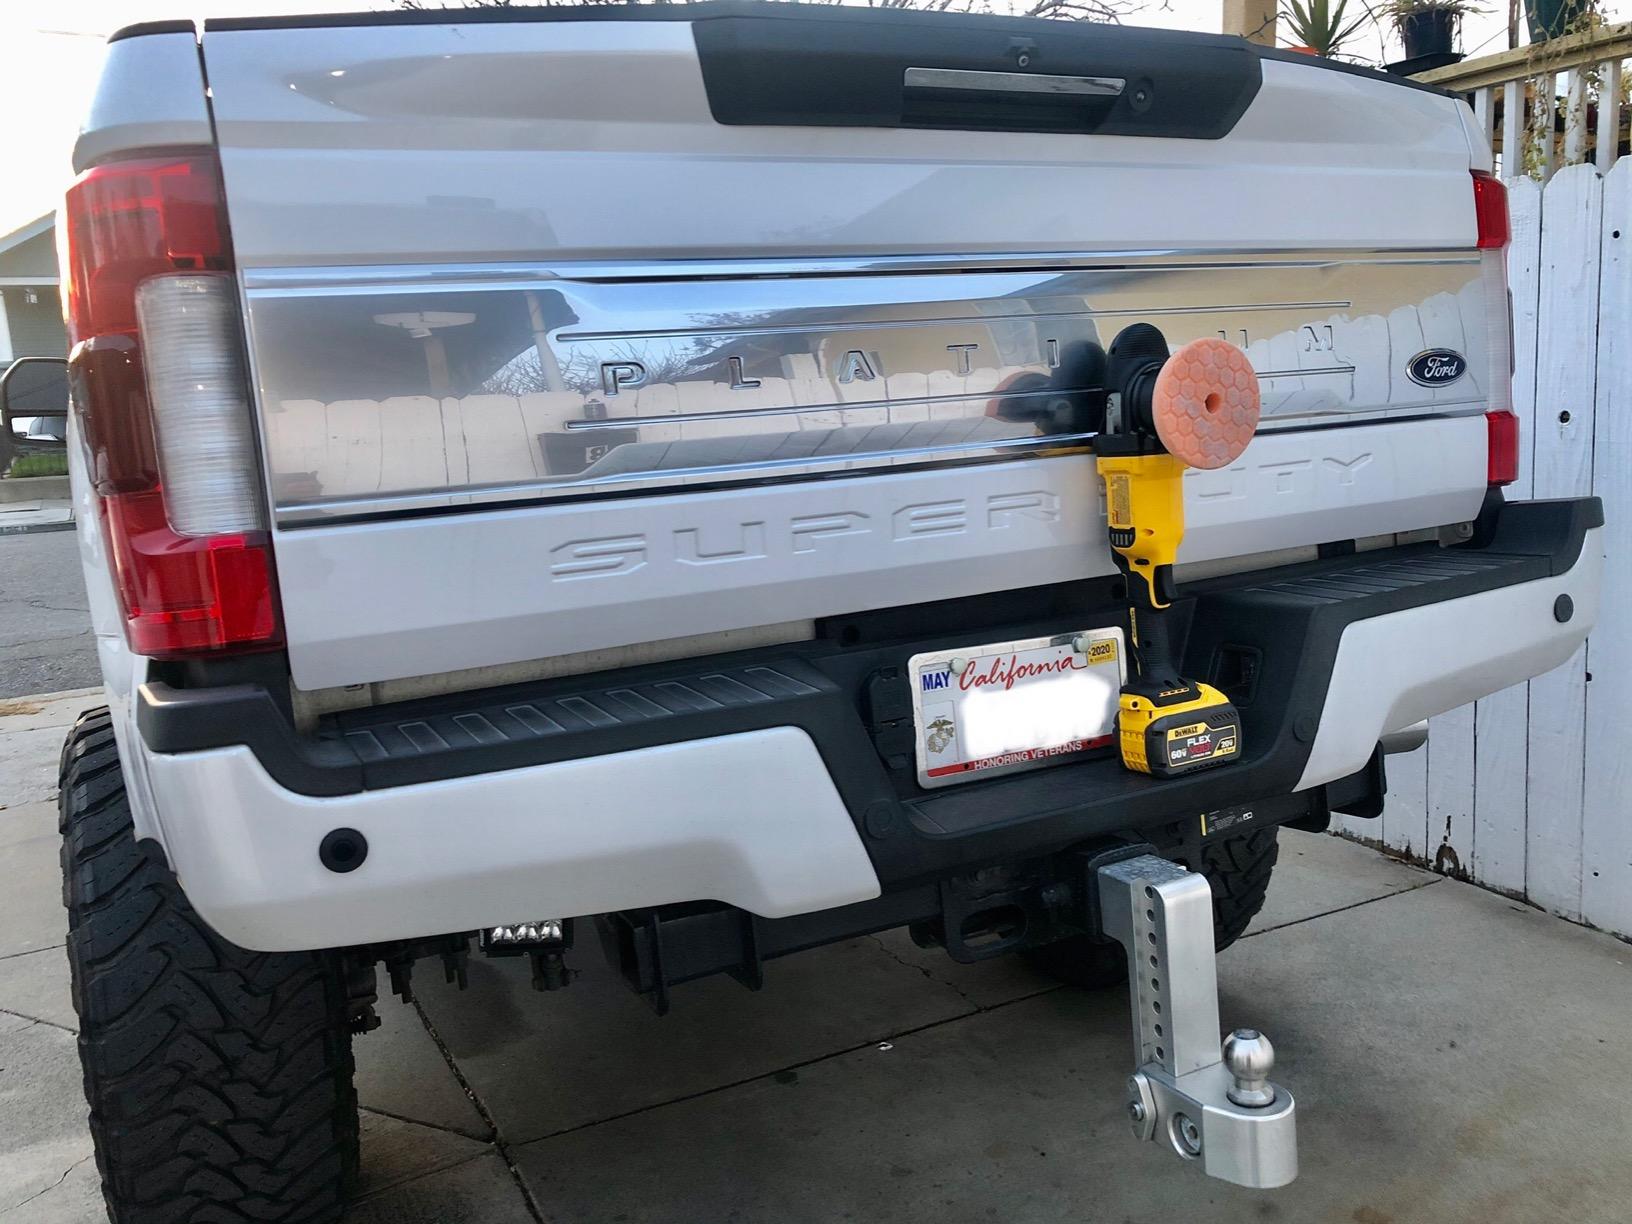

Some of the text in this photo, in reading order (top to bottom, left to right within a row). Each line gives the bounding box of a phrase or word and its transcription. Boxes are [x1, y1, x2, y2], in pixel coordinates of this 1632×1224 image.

[600, 325, 1335, 396] PLATIM
[1424, 356, 1458, 378] Ford
[550, 489, 1061, 583] SUPER
[1098, 452, 1373, 516] UTY
[1091, 643, 1110, 657] 2020
[923, 670, 951, 691] MAY
[959, 650, 1087, 690] California
[1187, 734, 1211, 747] FLEX
[974, 741, 1082, 769] HONORING VETERANS
